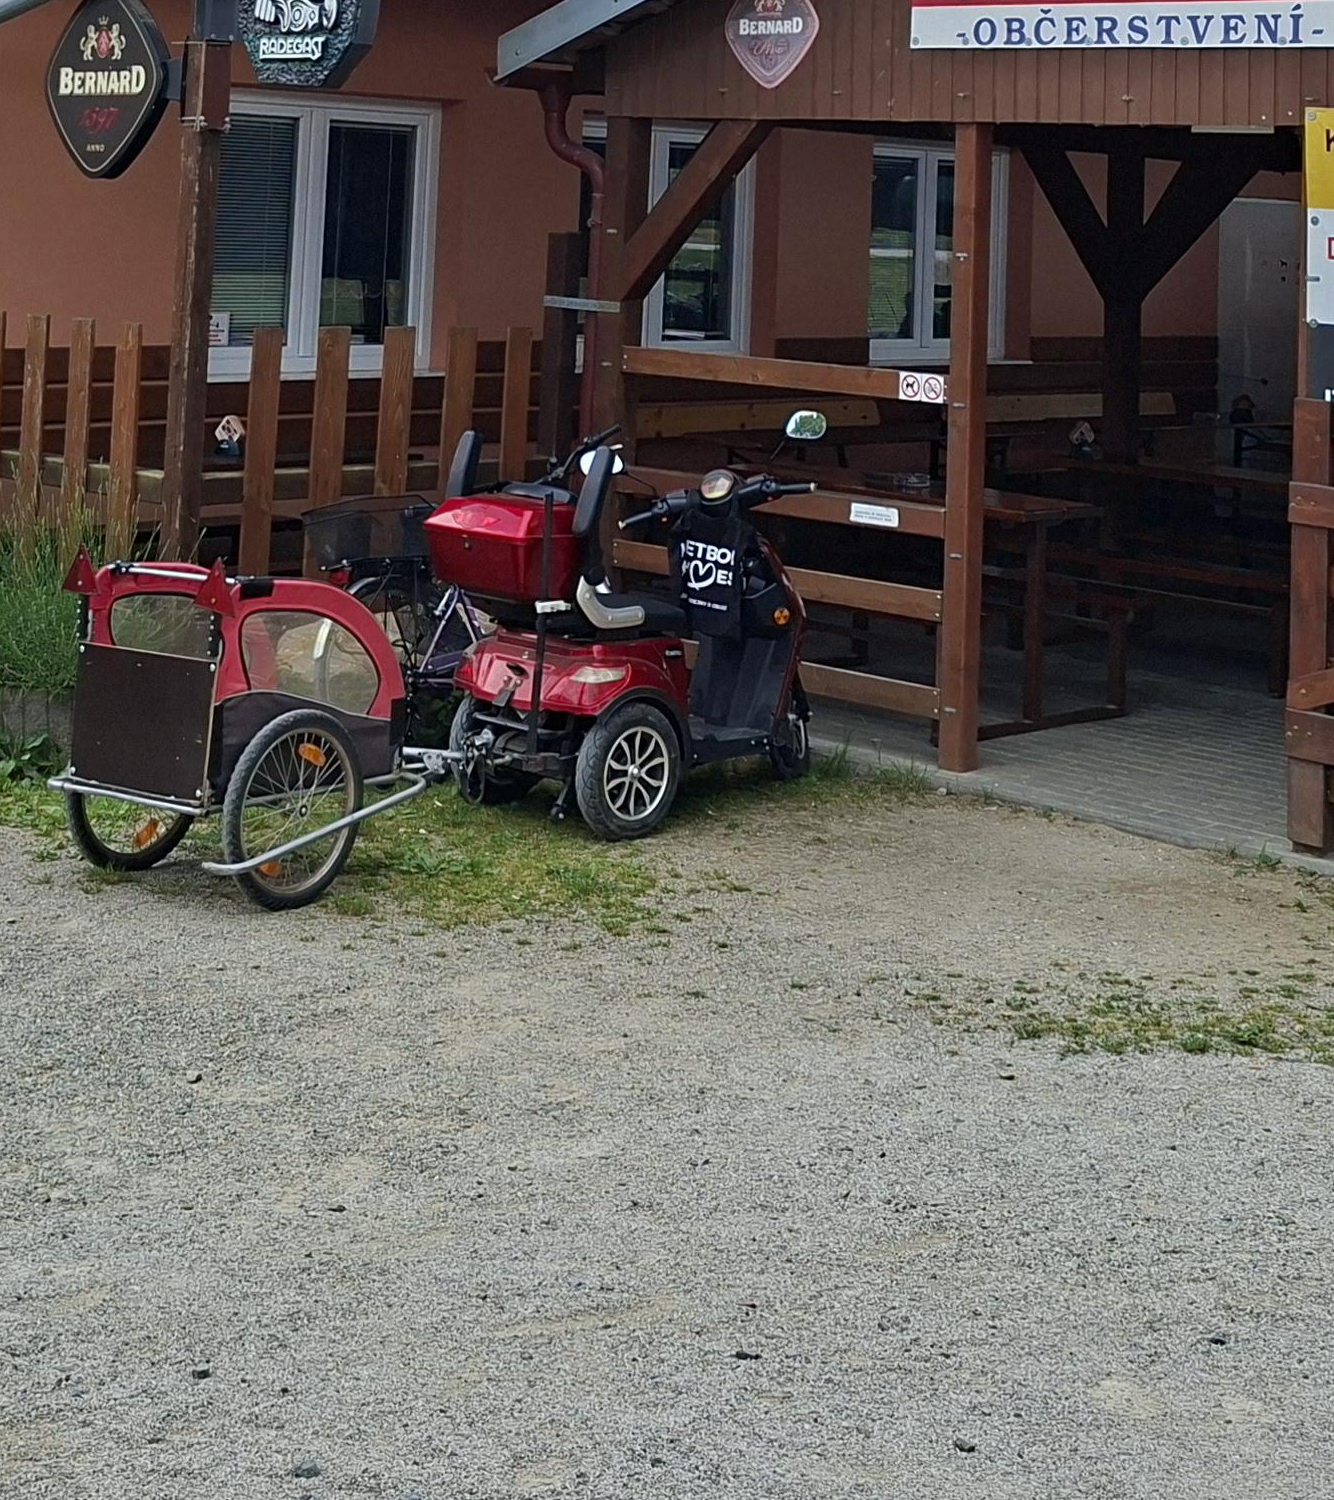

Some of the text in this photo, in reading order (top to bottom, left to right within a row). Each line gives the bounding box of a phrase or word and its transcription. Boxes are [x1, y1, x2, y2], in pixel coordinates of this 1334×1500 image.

[739, 17, 803, 35] BERNARD
[259, 36, 327, 60] RADEGAST
[58, 65, 146, 96] BERNARD
